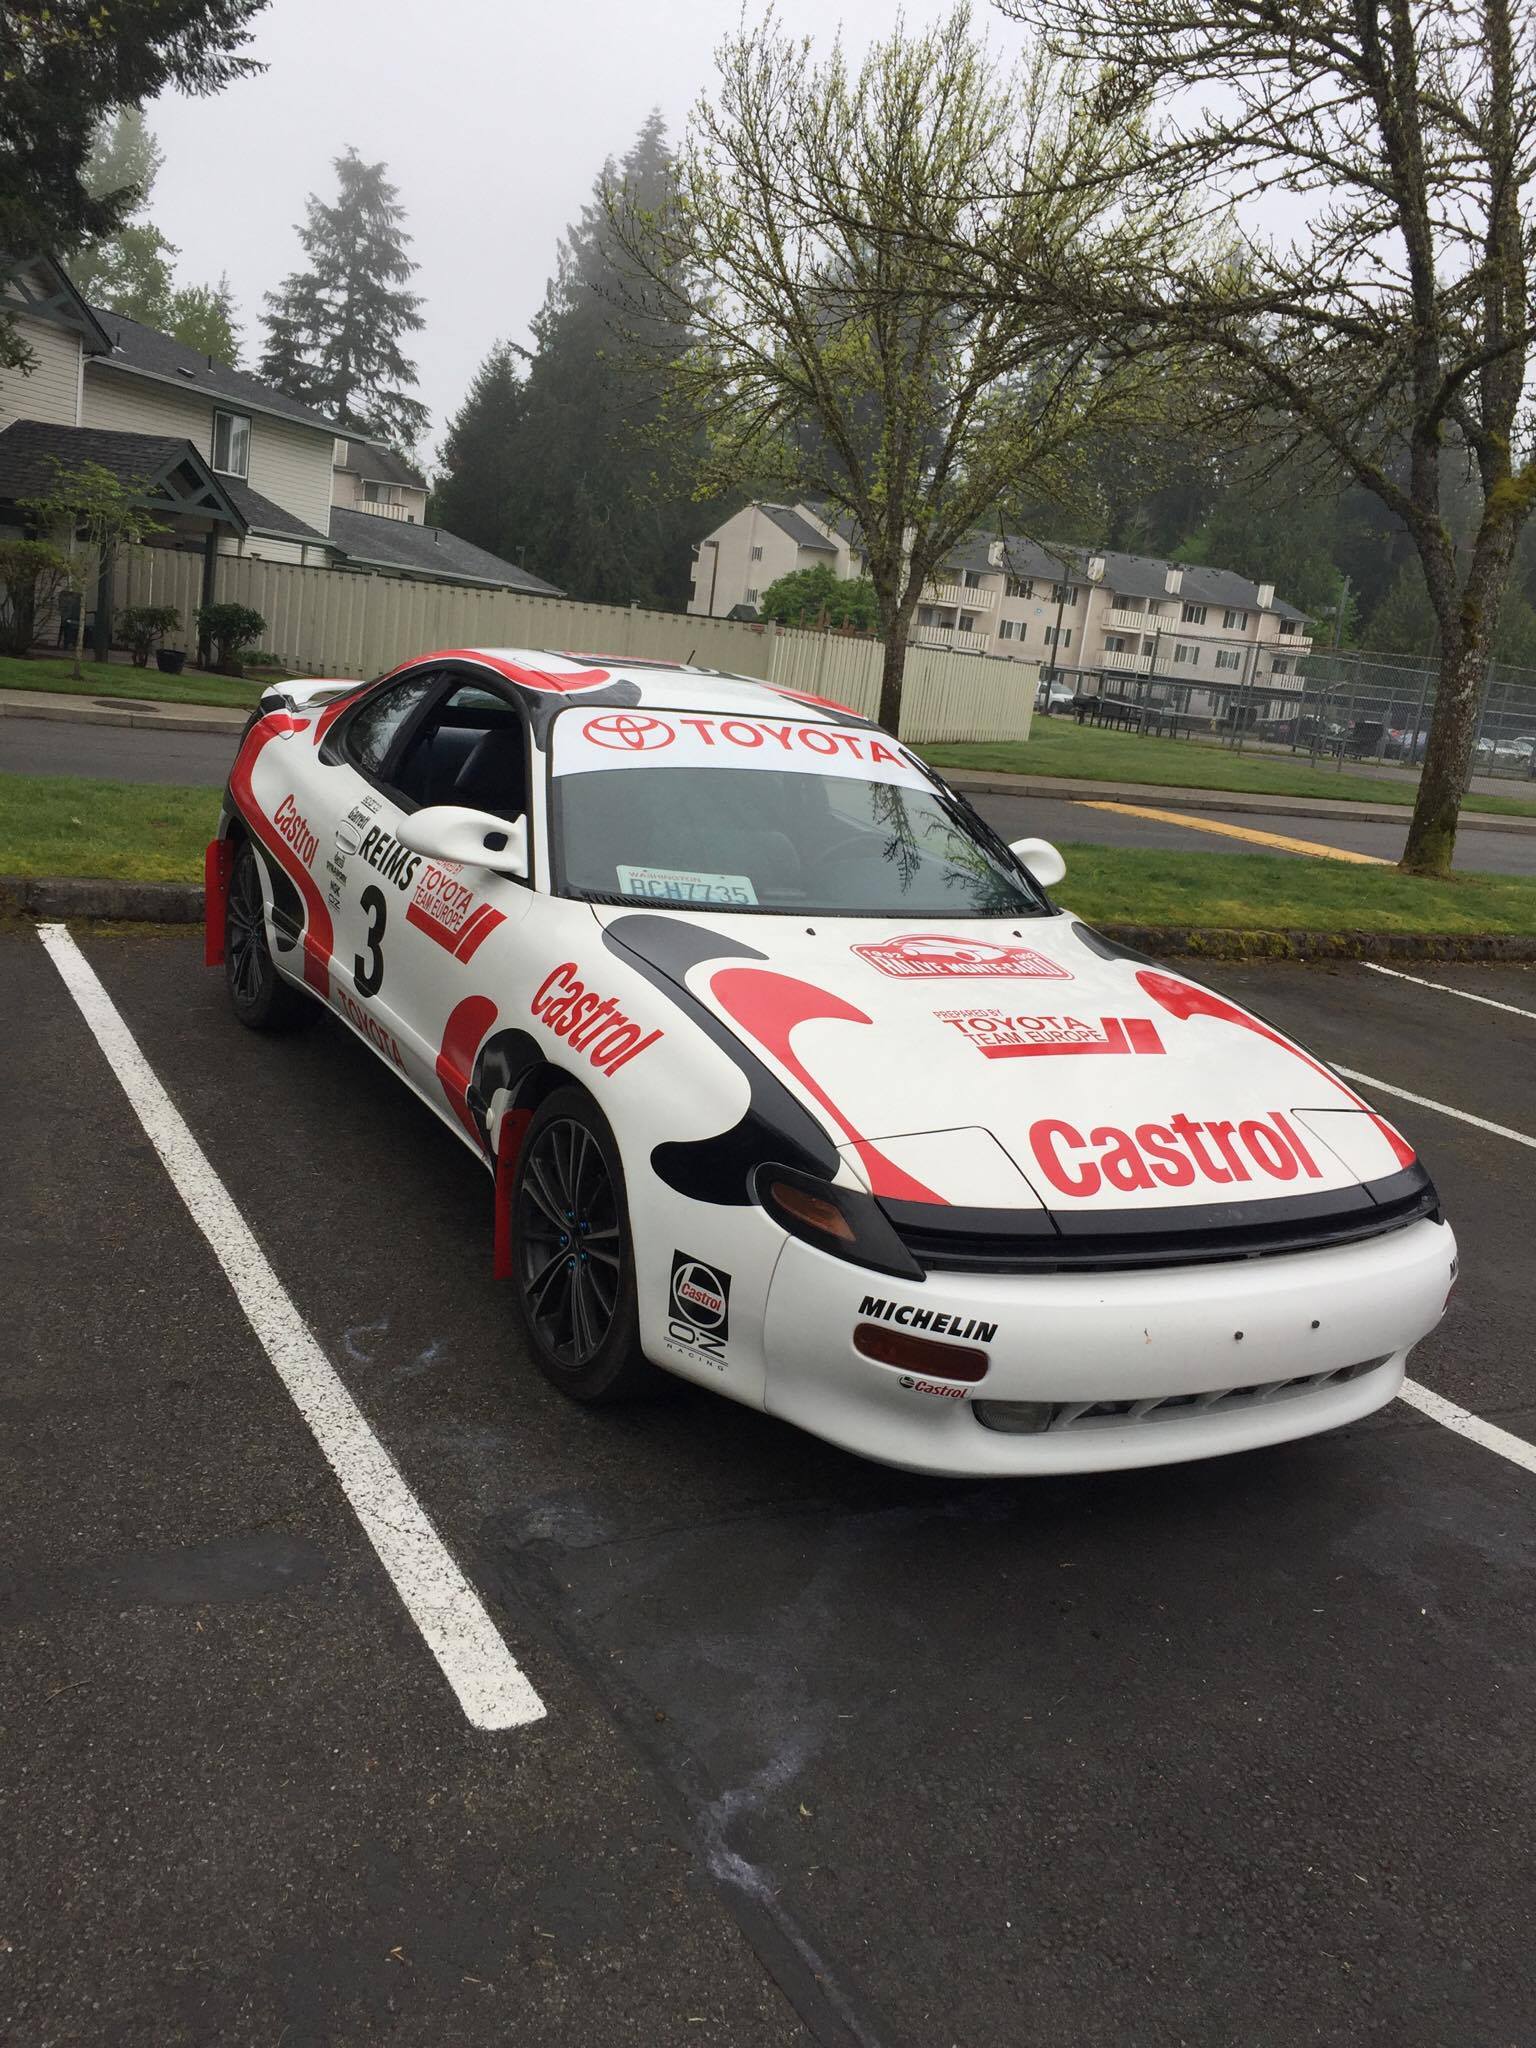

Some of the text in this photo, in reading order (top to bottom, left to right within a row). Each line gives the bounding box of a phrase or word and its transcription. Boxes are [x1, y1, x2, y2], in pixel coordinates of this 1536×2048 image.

[680, 718, 908, 769] TOYOTA
[274, 793, 320, 870] Castrol
[358, 824, 423, 891] REIMS
[412, 885, 464, 932] TEAM EUROPE
[420, 864, 474, 914] TOYOTA
[353, 884, 387, 998] 3
[872, 957, 949, 975] RALLYE
[337, 987, 410, 1078] TOYOTA
[530, 962, 665, 1078] Castrol
[932, 1008, 1005, 1019] PREPARED BY
[942, 1016, 1093, 1034] TOYOTA
[963, 1030, 1108, 1046] TEAM EUROPE
[1029, 1111, 1324, 1198] Castrol
[680, 1282, 722, 1312] Castrol
[858, 1295, 999, 1343] MICHELIN
[666, 1343, 725, 1371] RACING
[914, 1380, 969, 1399] Castrol
